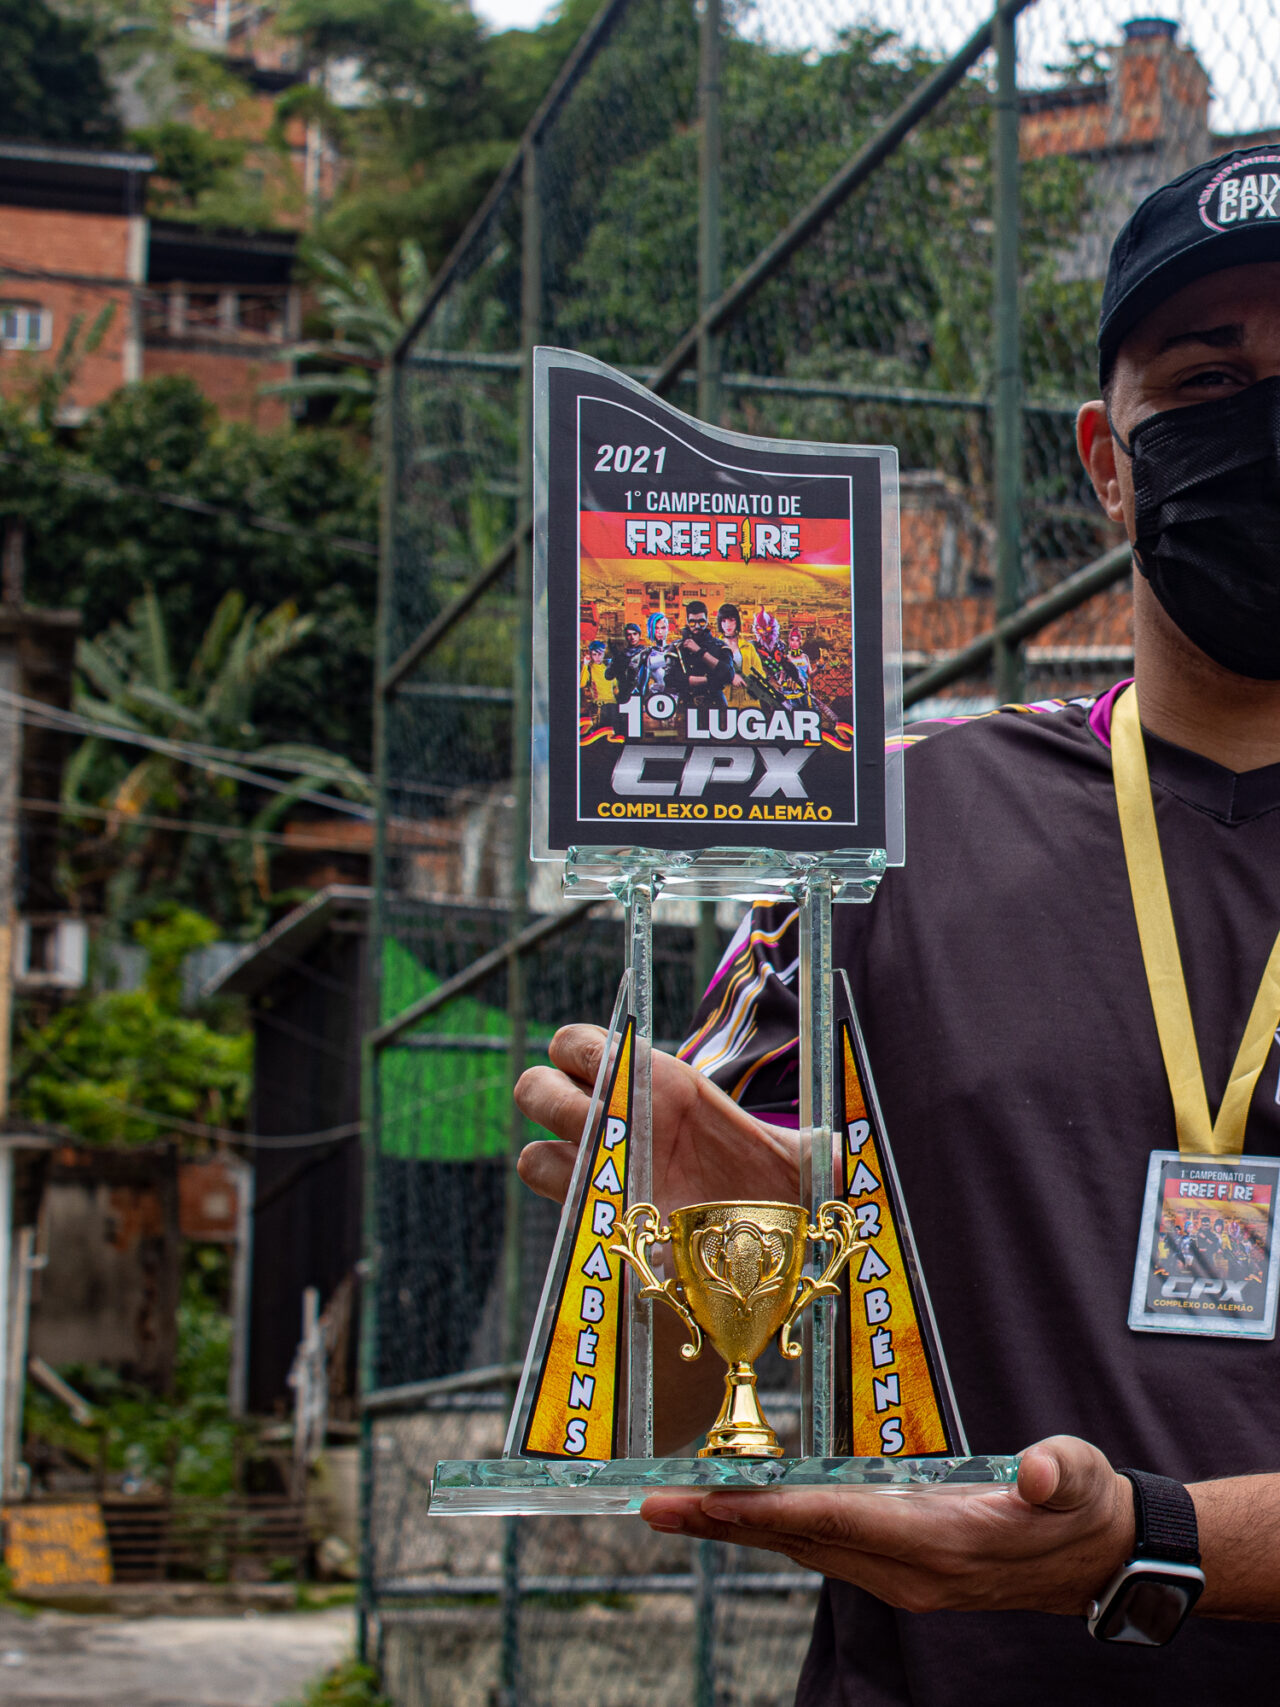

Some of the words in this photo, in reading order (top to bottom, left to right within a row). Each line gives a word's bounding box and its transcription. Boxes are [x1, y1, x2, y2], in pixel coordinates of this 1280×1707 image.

[1218, 193, 1278, 224] CPX
[594, 444, 667, 474] 2021
[646, 491, 773, 515] CAMPEONATO
[778, 495, 801, 515] DE
[624, 518, 711, 556] FREE
[686, 708, 822, 742] LUGAR
[611, 745, 817, 799] CPX
[597, 802, 708, 819] COMPLEXO
[714, 804, 743, 819] DO
[748, 801, 833, 821] ALEMÃO
[1180, 1181, 1216, 1199] FREE
[1189, 1170, 1244, 1182] CAMPEONATO
[1245, 1174, 1256, 1183] DE
[564, 1117, 627, 1454] PARABÉNS
[847, 1118, 905, 1457] PARABÉNS
[1161, 1276, 1248, 1302] CPX
[1153, 1299, 1201, 1309] COMPLEXO
[1202, 1302, 1215, 1310] DO
[1217, 1303, 1254, 1312] ALEMÃO
